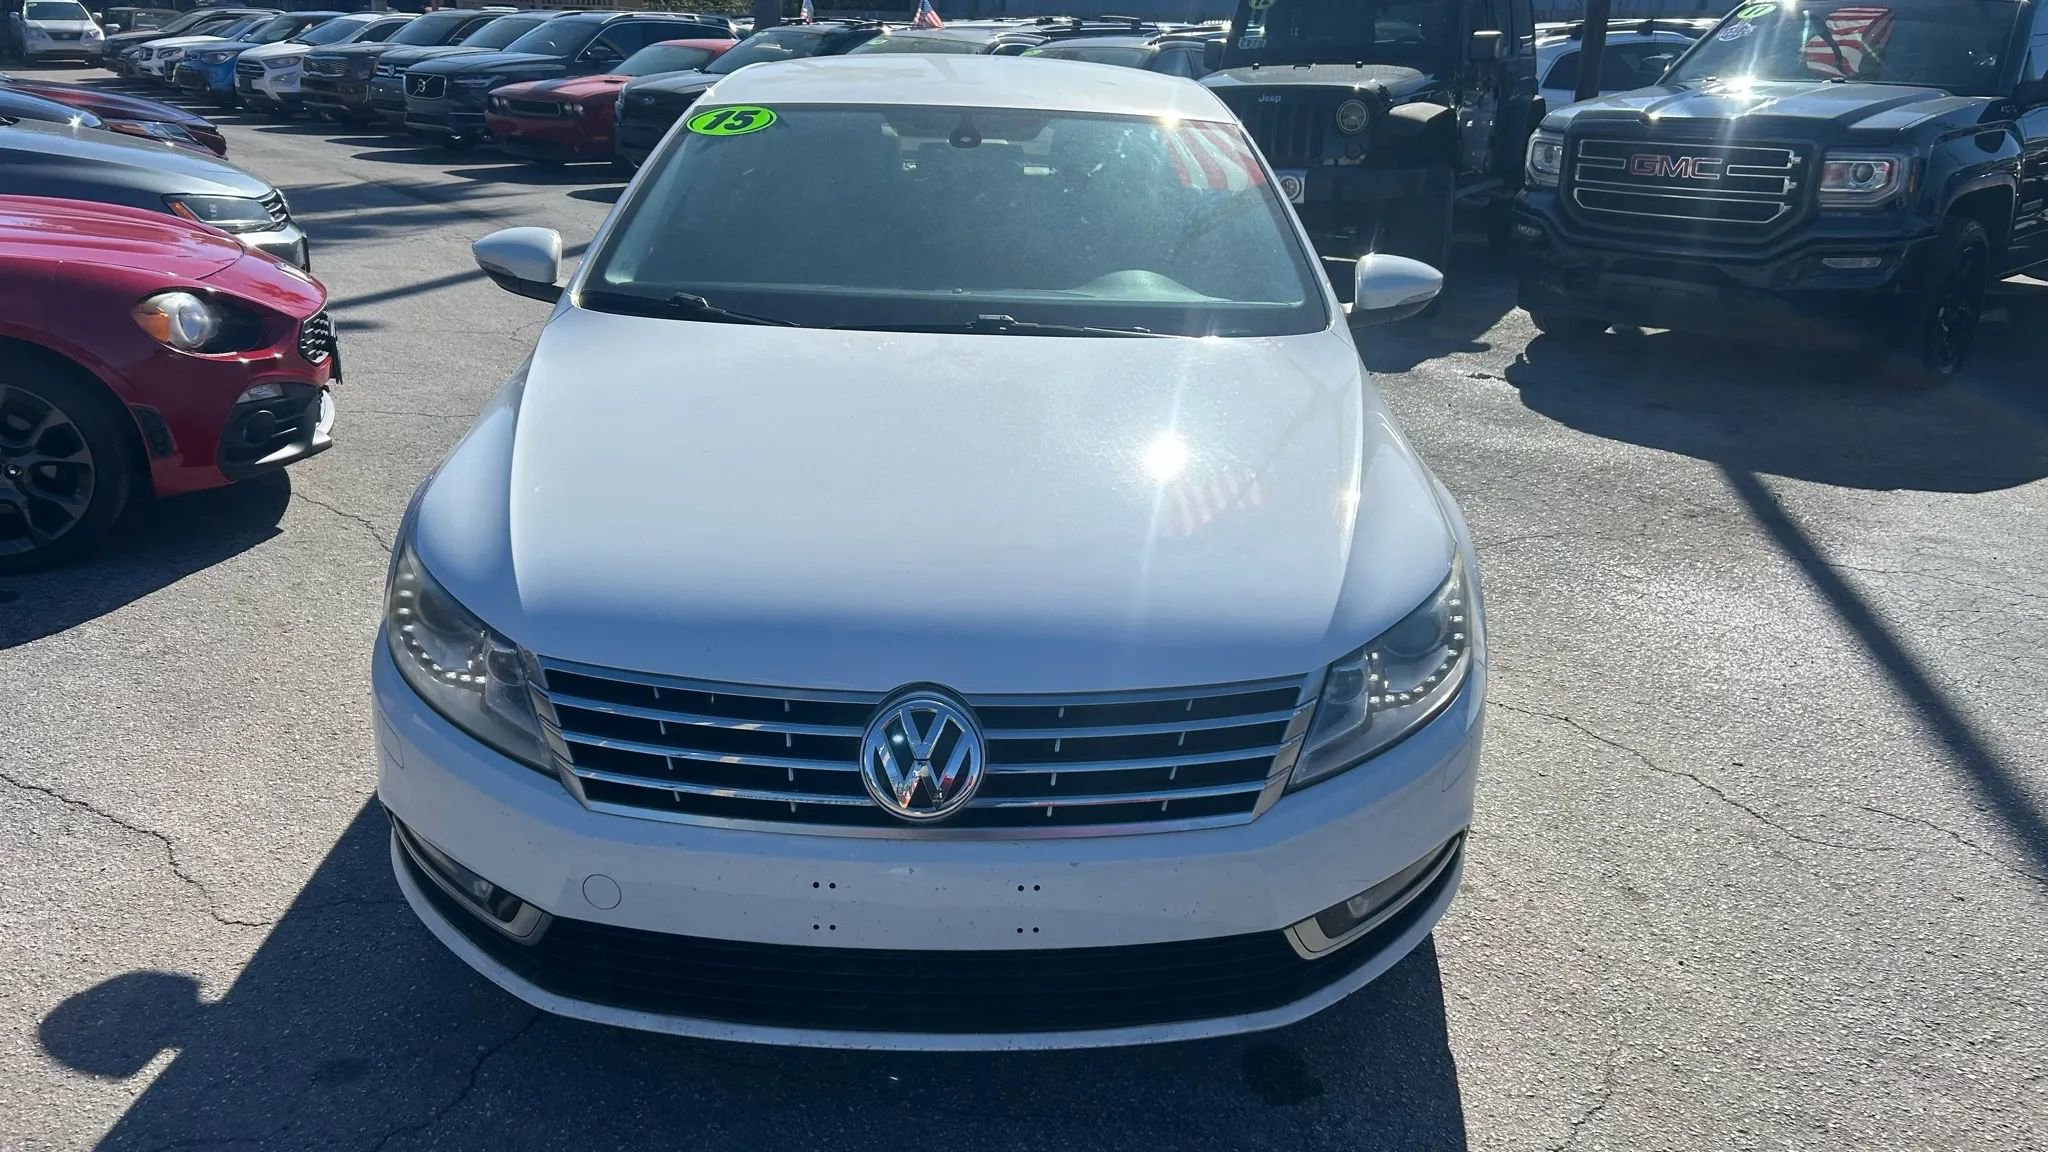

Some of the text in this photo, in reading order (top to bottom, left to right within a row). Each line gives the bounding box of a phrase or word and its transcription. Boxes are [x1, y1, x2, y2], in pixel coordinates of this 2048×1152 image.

[1258, 93, 1282, 104] Jeep
[703, 109, 763, 131] 15
[1630, 154, 1722, 180] GMC
[861, 699, 983, 816] VW
